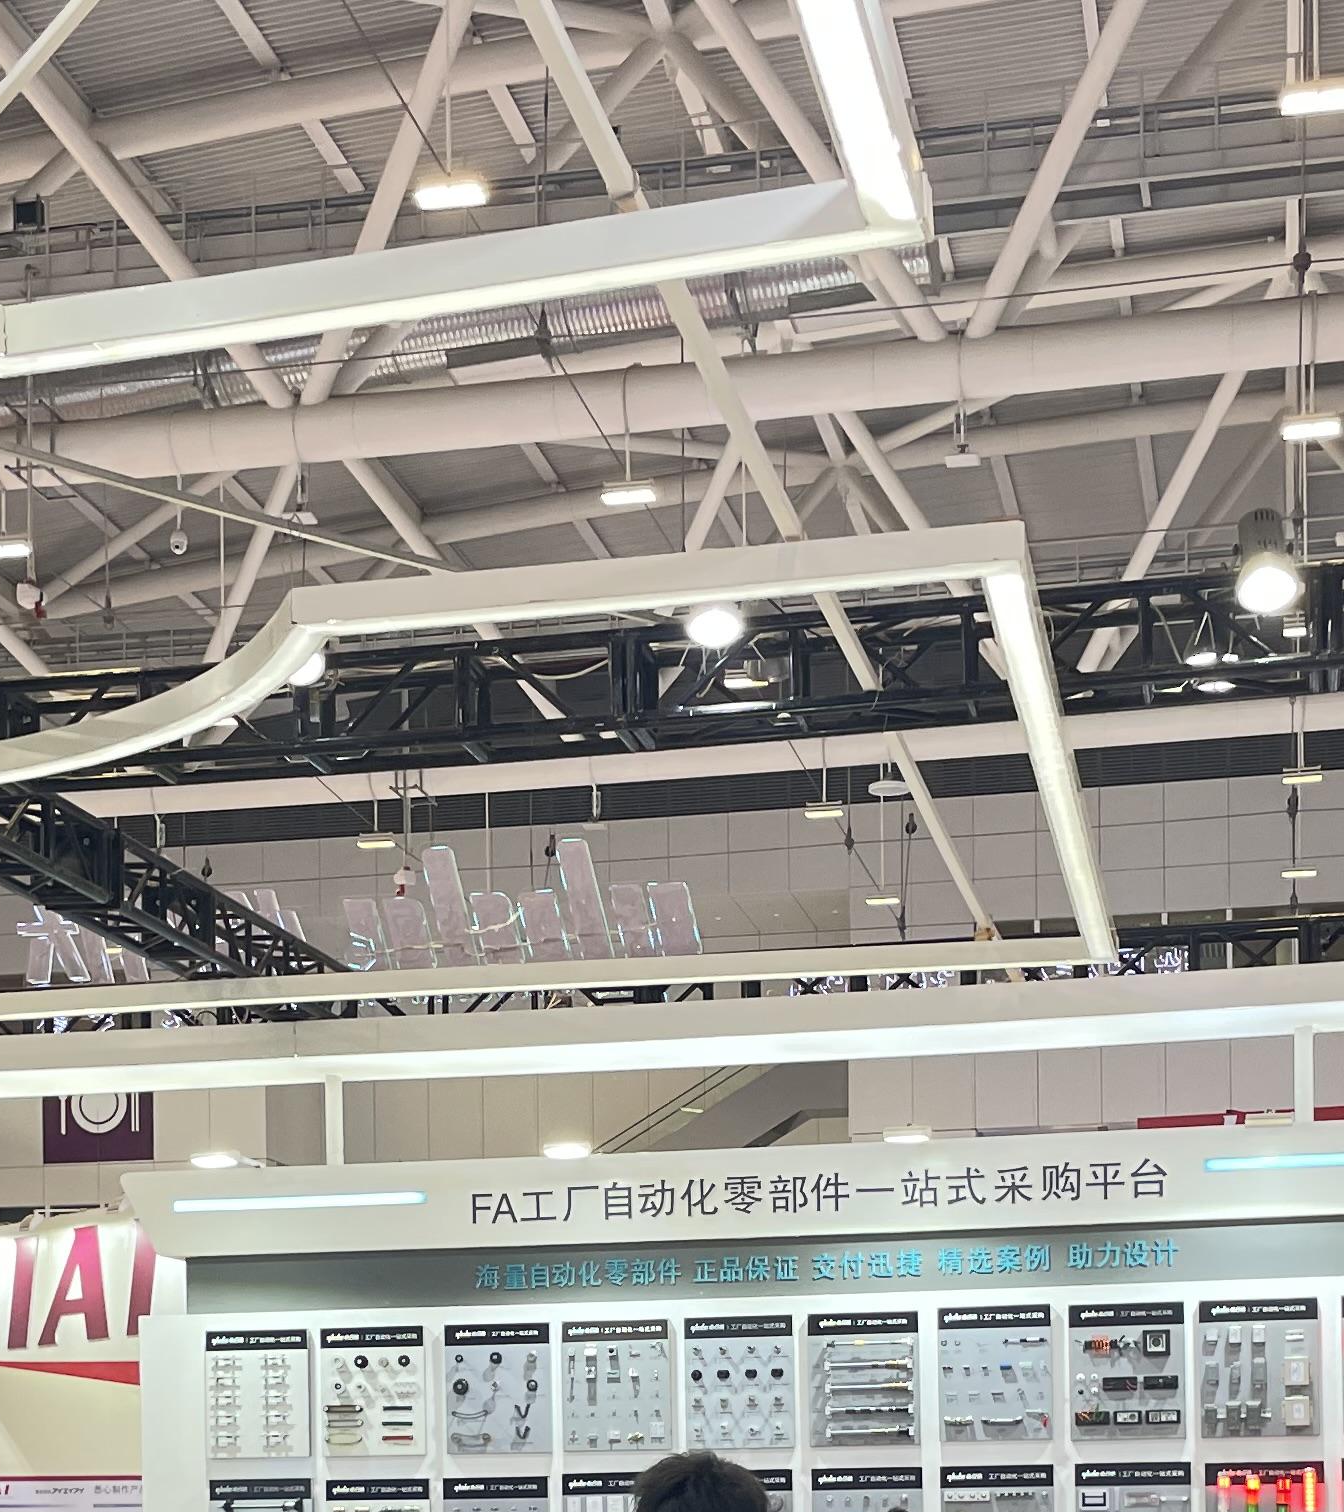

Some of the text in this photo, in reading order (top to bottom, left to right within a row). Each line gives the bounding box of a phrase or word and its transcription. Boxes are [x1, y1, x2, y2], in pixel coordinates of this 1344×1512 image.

[471, 1158, 1168, 1225] FA工厂自动化零部件一站式采购平台
[8, 1219, 156, 1349] IAI
[475, 1238, 1179, 1290] 海量自动化零部件 正品保证 交付迅捷 精选案例 助力设计
